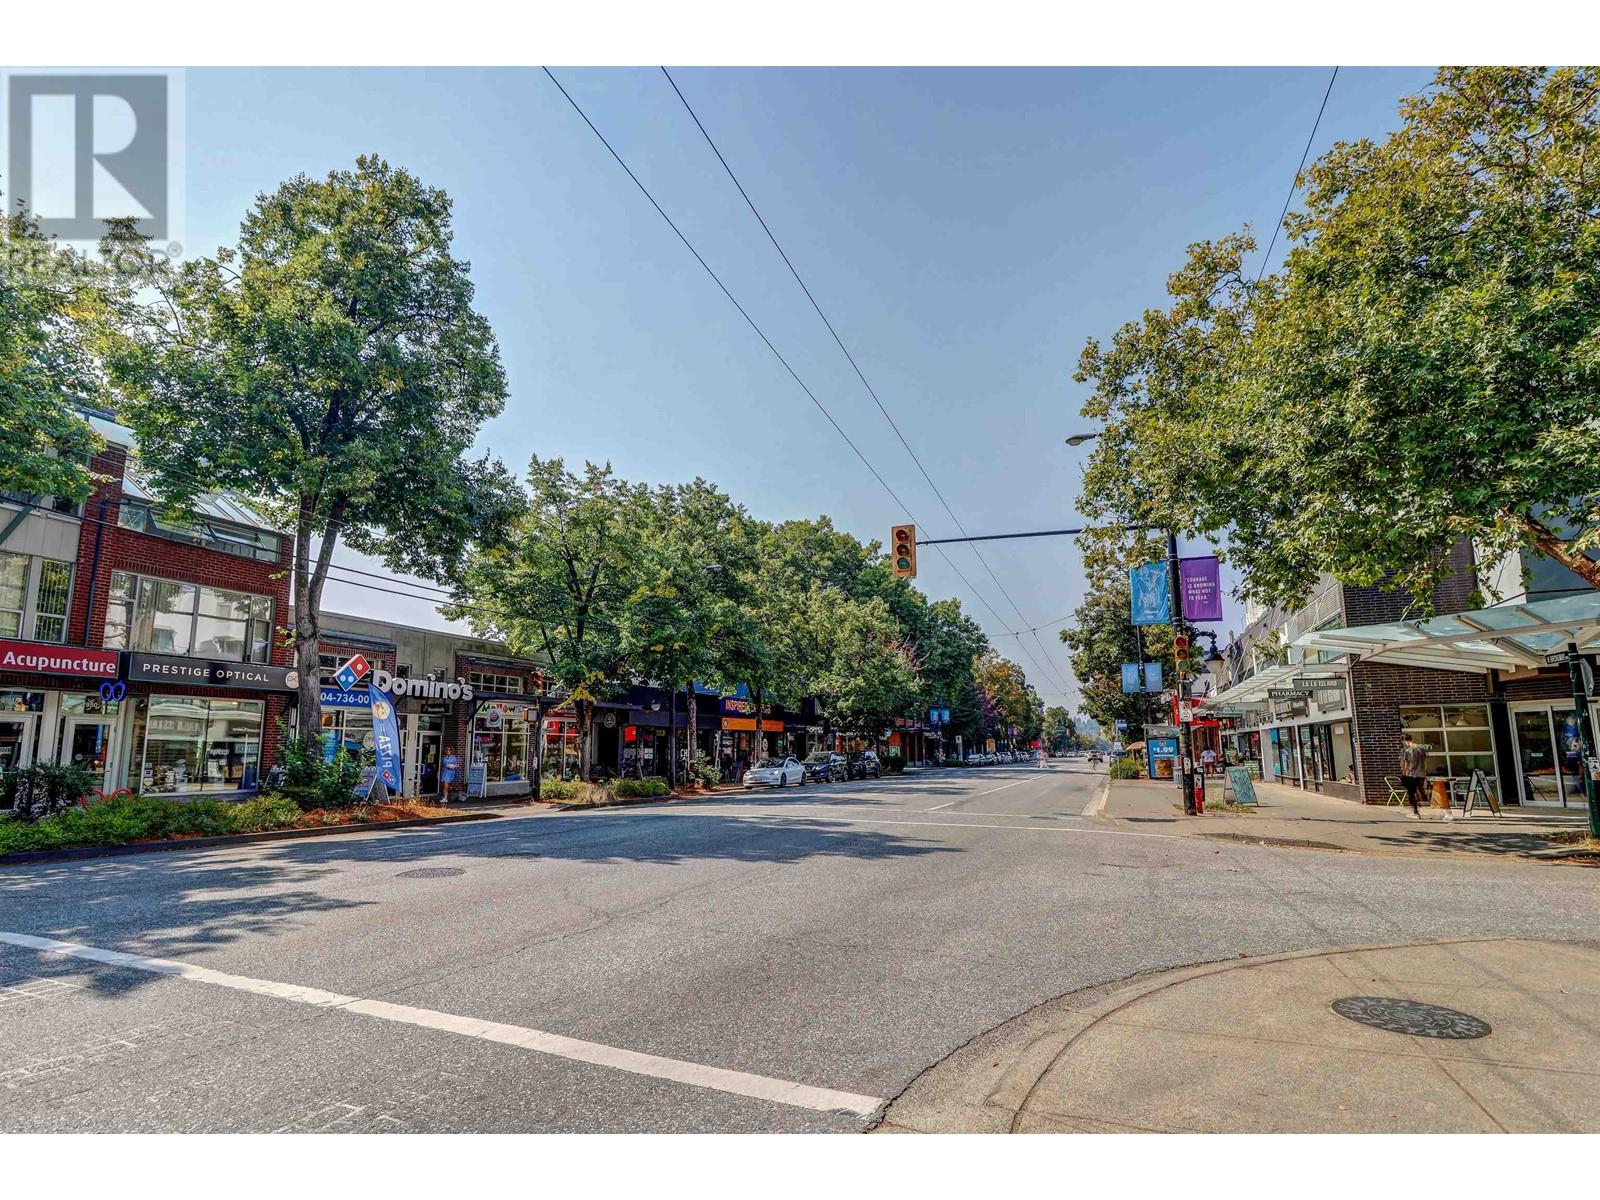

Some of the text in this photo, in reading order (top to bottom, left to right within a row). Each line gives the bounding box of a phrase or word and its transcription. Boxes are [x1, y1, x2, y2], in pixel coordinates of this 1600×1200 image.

[3, 651, 116, 673] Acupuncture
[142, 663, 269, 682] PRESTIGE OPTICAL
[373, 670, 474, 701] Domino's
